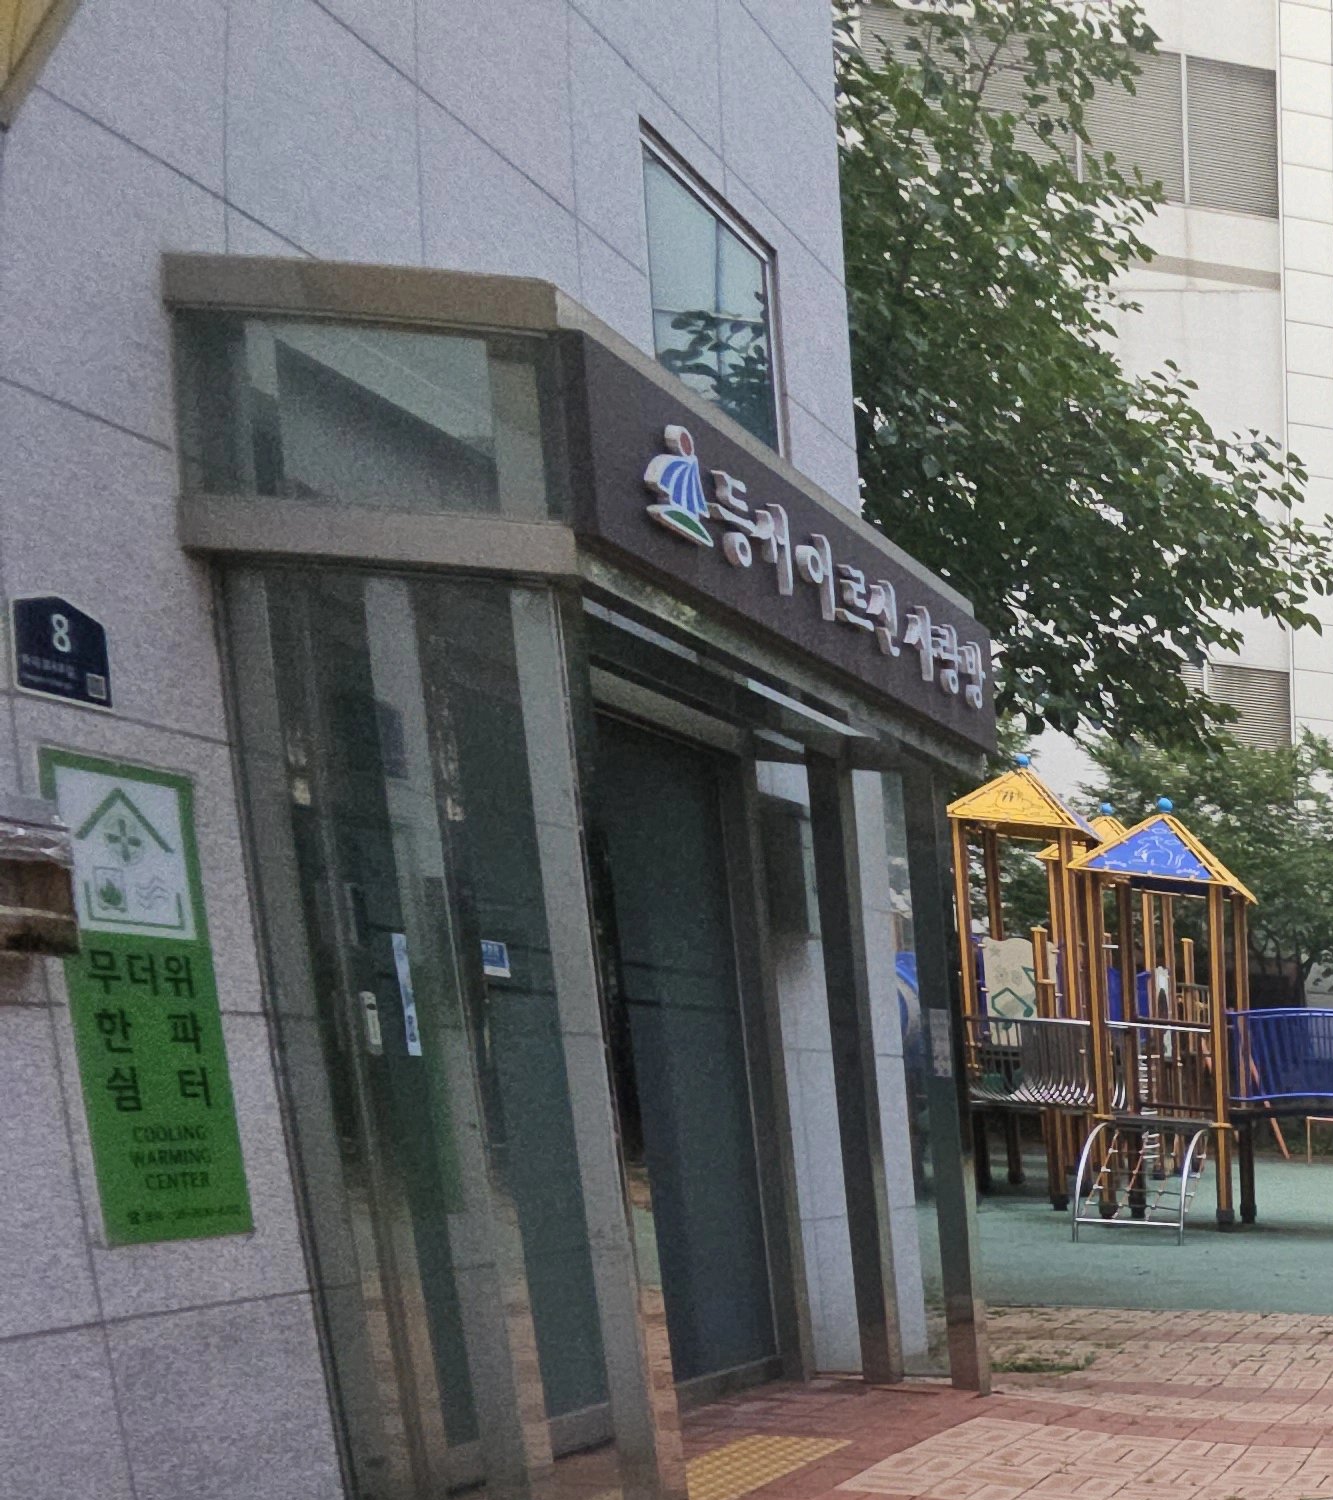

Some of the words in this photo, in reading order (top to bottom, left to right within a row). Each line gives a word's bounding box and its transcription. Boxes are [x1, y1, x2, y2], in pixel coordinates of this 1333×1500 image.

[52, 614, 71, 652] 8
[88, 951, 195, 998] 무더위
[132, 1125, 206, 1143] COOLING
[129, 1149, 212, 1168] WARMING
[144, 1171, 210, 1191] CENTER
